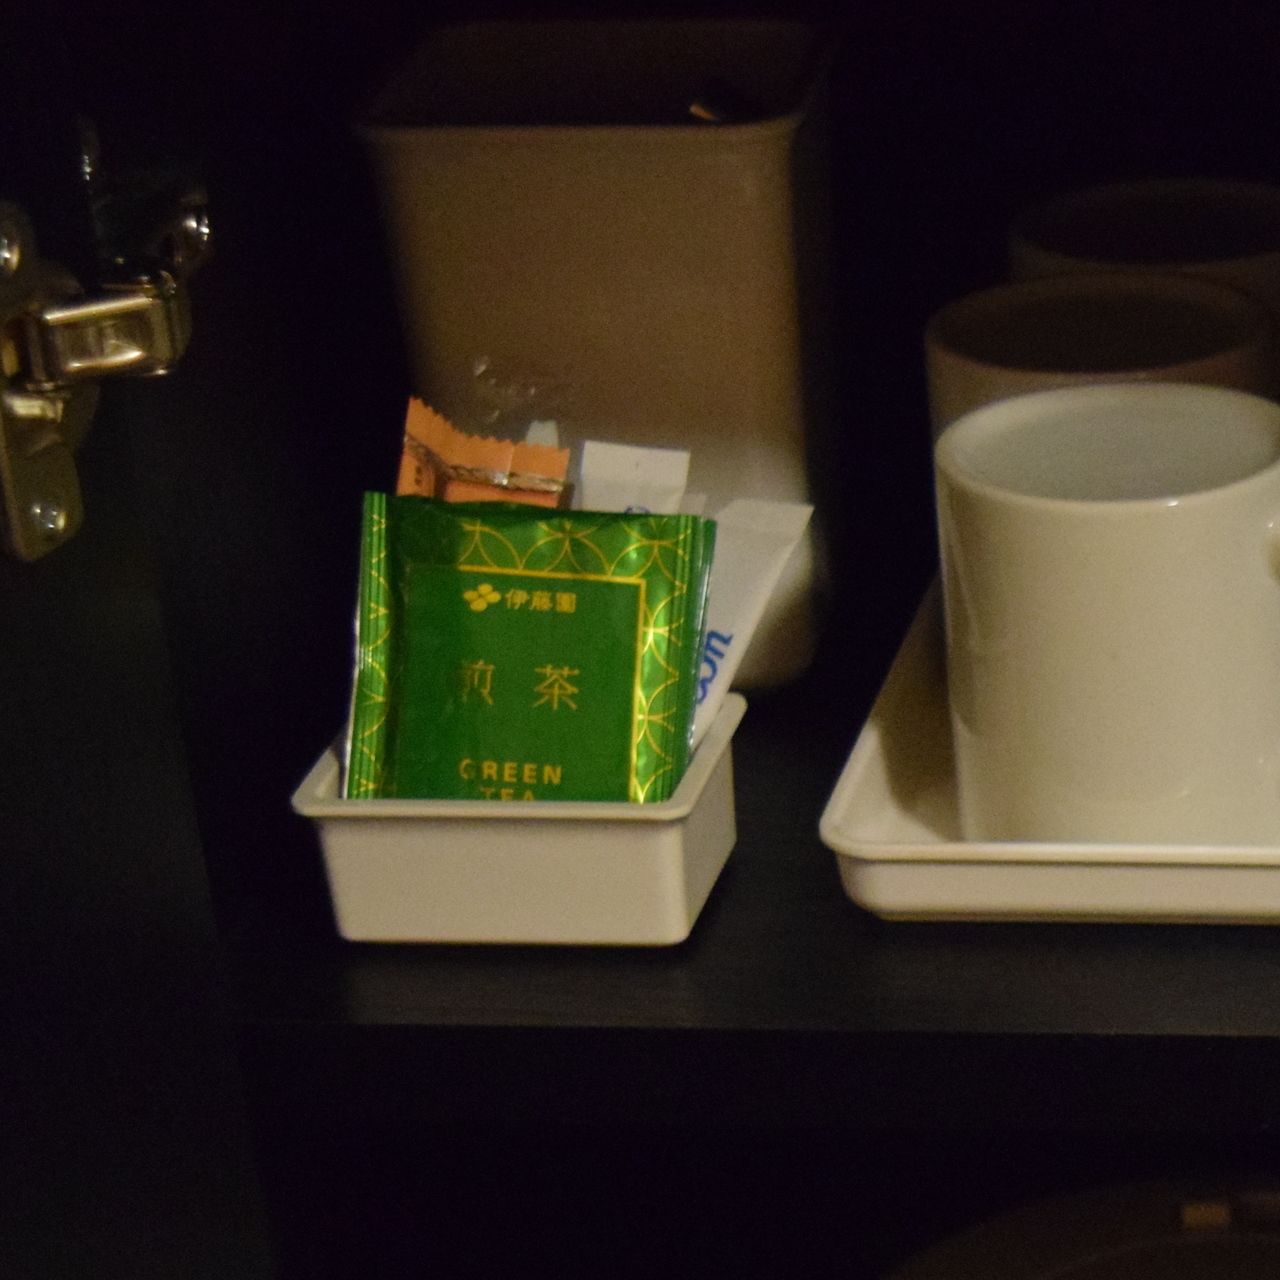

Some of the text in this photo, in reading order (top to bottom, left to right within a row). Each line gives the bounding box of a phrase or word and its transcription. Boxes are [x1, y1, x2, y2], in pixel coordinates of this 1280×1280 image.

[504, 588, 577, 614] 伊藤園
[458, 757, 562, 785] GREEN
